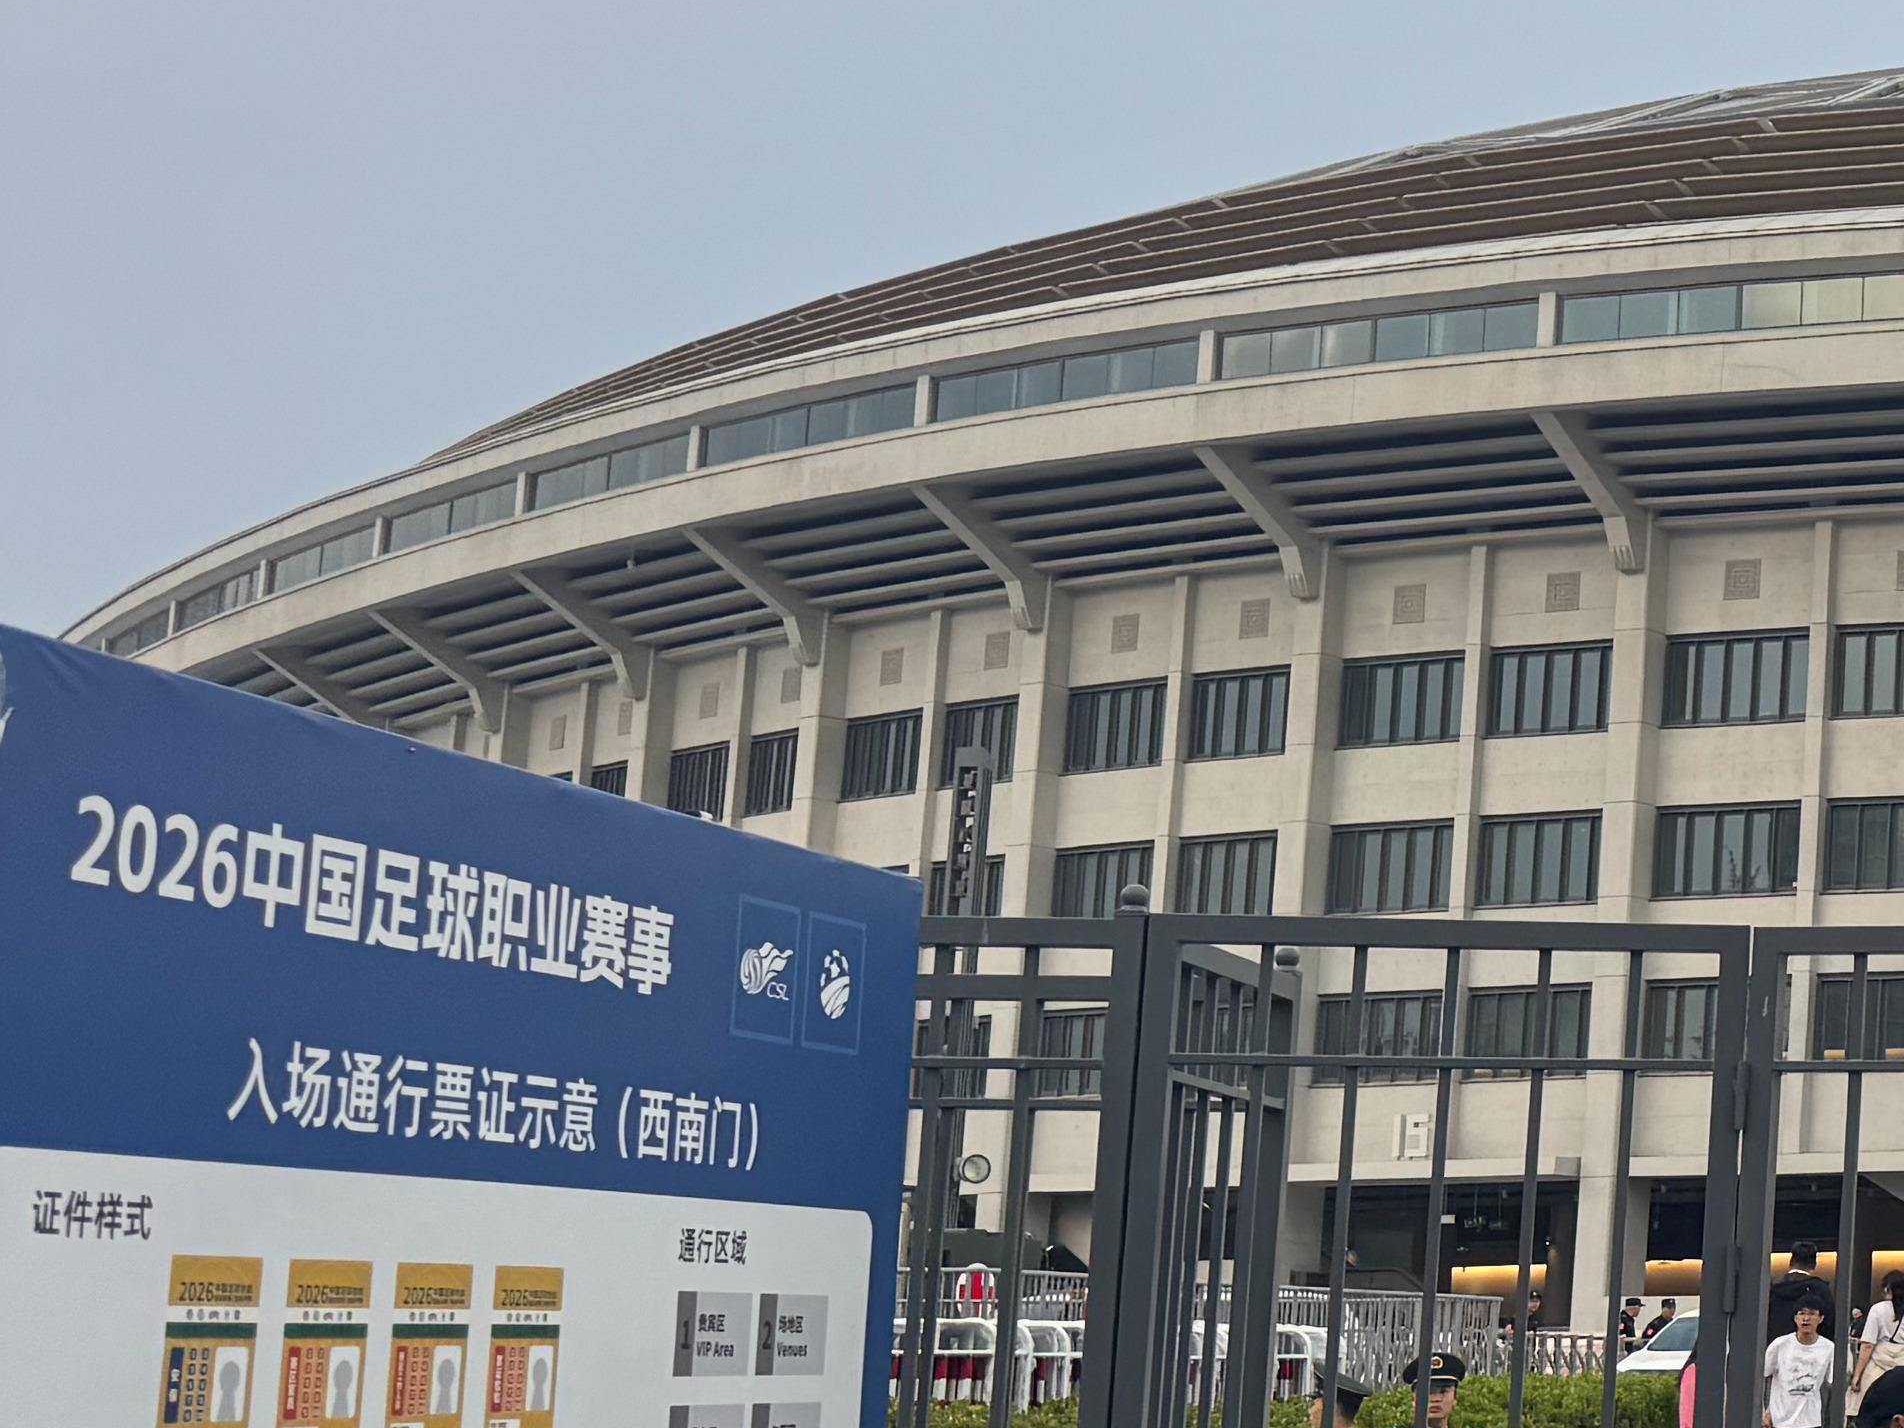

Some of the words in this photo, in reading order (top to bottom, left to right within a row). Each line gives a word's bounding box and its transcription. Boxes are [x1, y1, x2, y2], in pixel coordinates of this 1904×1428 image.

[71, 795, 675, 996] 2026中国足球职业赛事
[767, 981, 789, 1001] CSL
[33, 1190, 153, 1240] 证件样式
[678, 1228, 747, 1265] 通行区域
[696, 1341, 712, 1357] VIP
[713, 1341, 735, 1357] Area
[762, 1320, 772, 1350] 2
